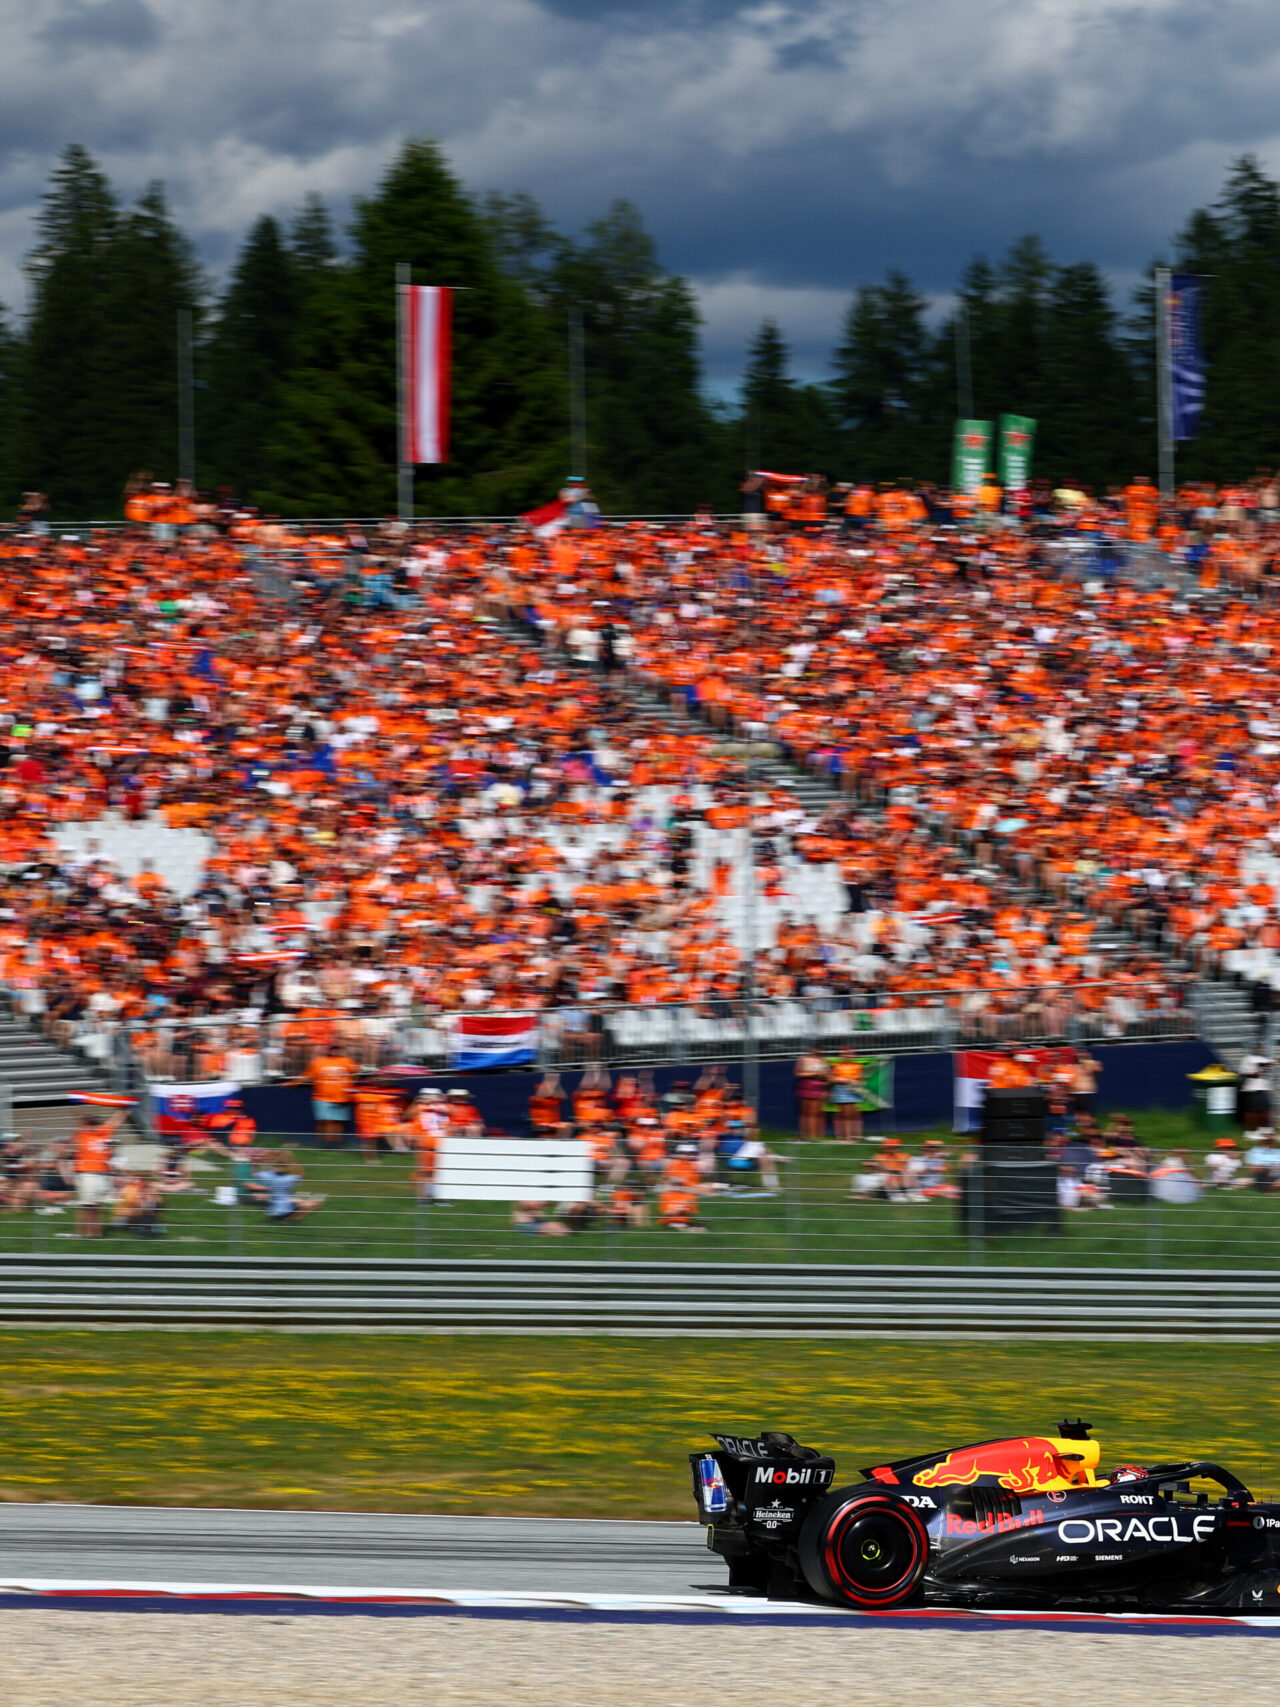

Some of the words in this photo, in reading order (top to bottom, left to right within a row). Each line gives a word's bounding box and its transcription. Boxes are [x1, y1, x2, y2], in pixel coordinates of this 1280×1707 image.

[755, 1467, 811, 1484] Mobil
[1120, 1495, 1154, 1505] ROKT
[756, 1511, 791, 1519] Heineken
[946, 1512, 995, 1535] Red
[997, 1509, 1045, 1533] Bull
[1058, 1515, 1216, 1543] ORACLE
